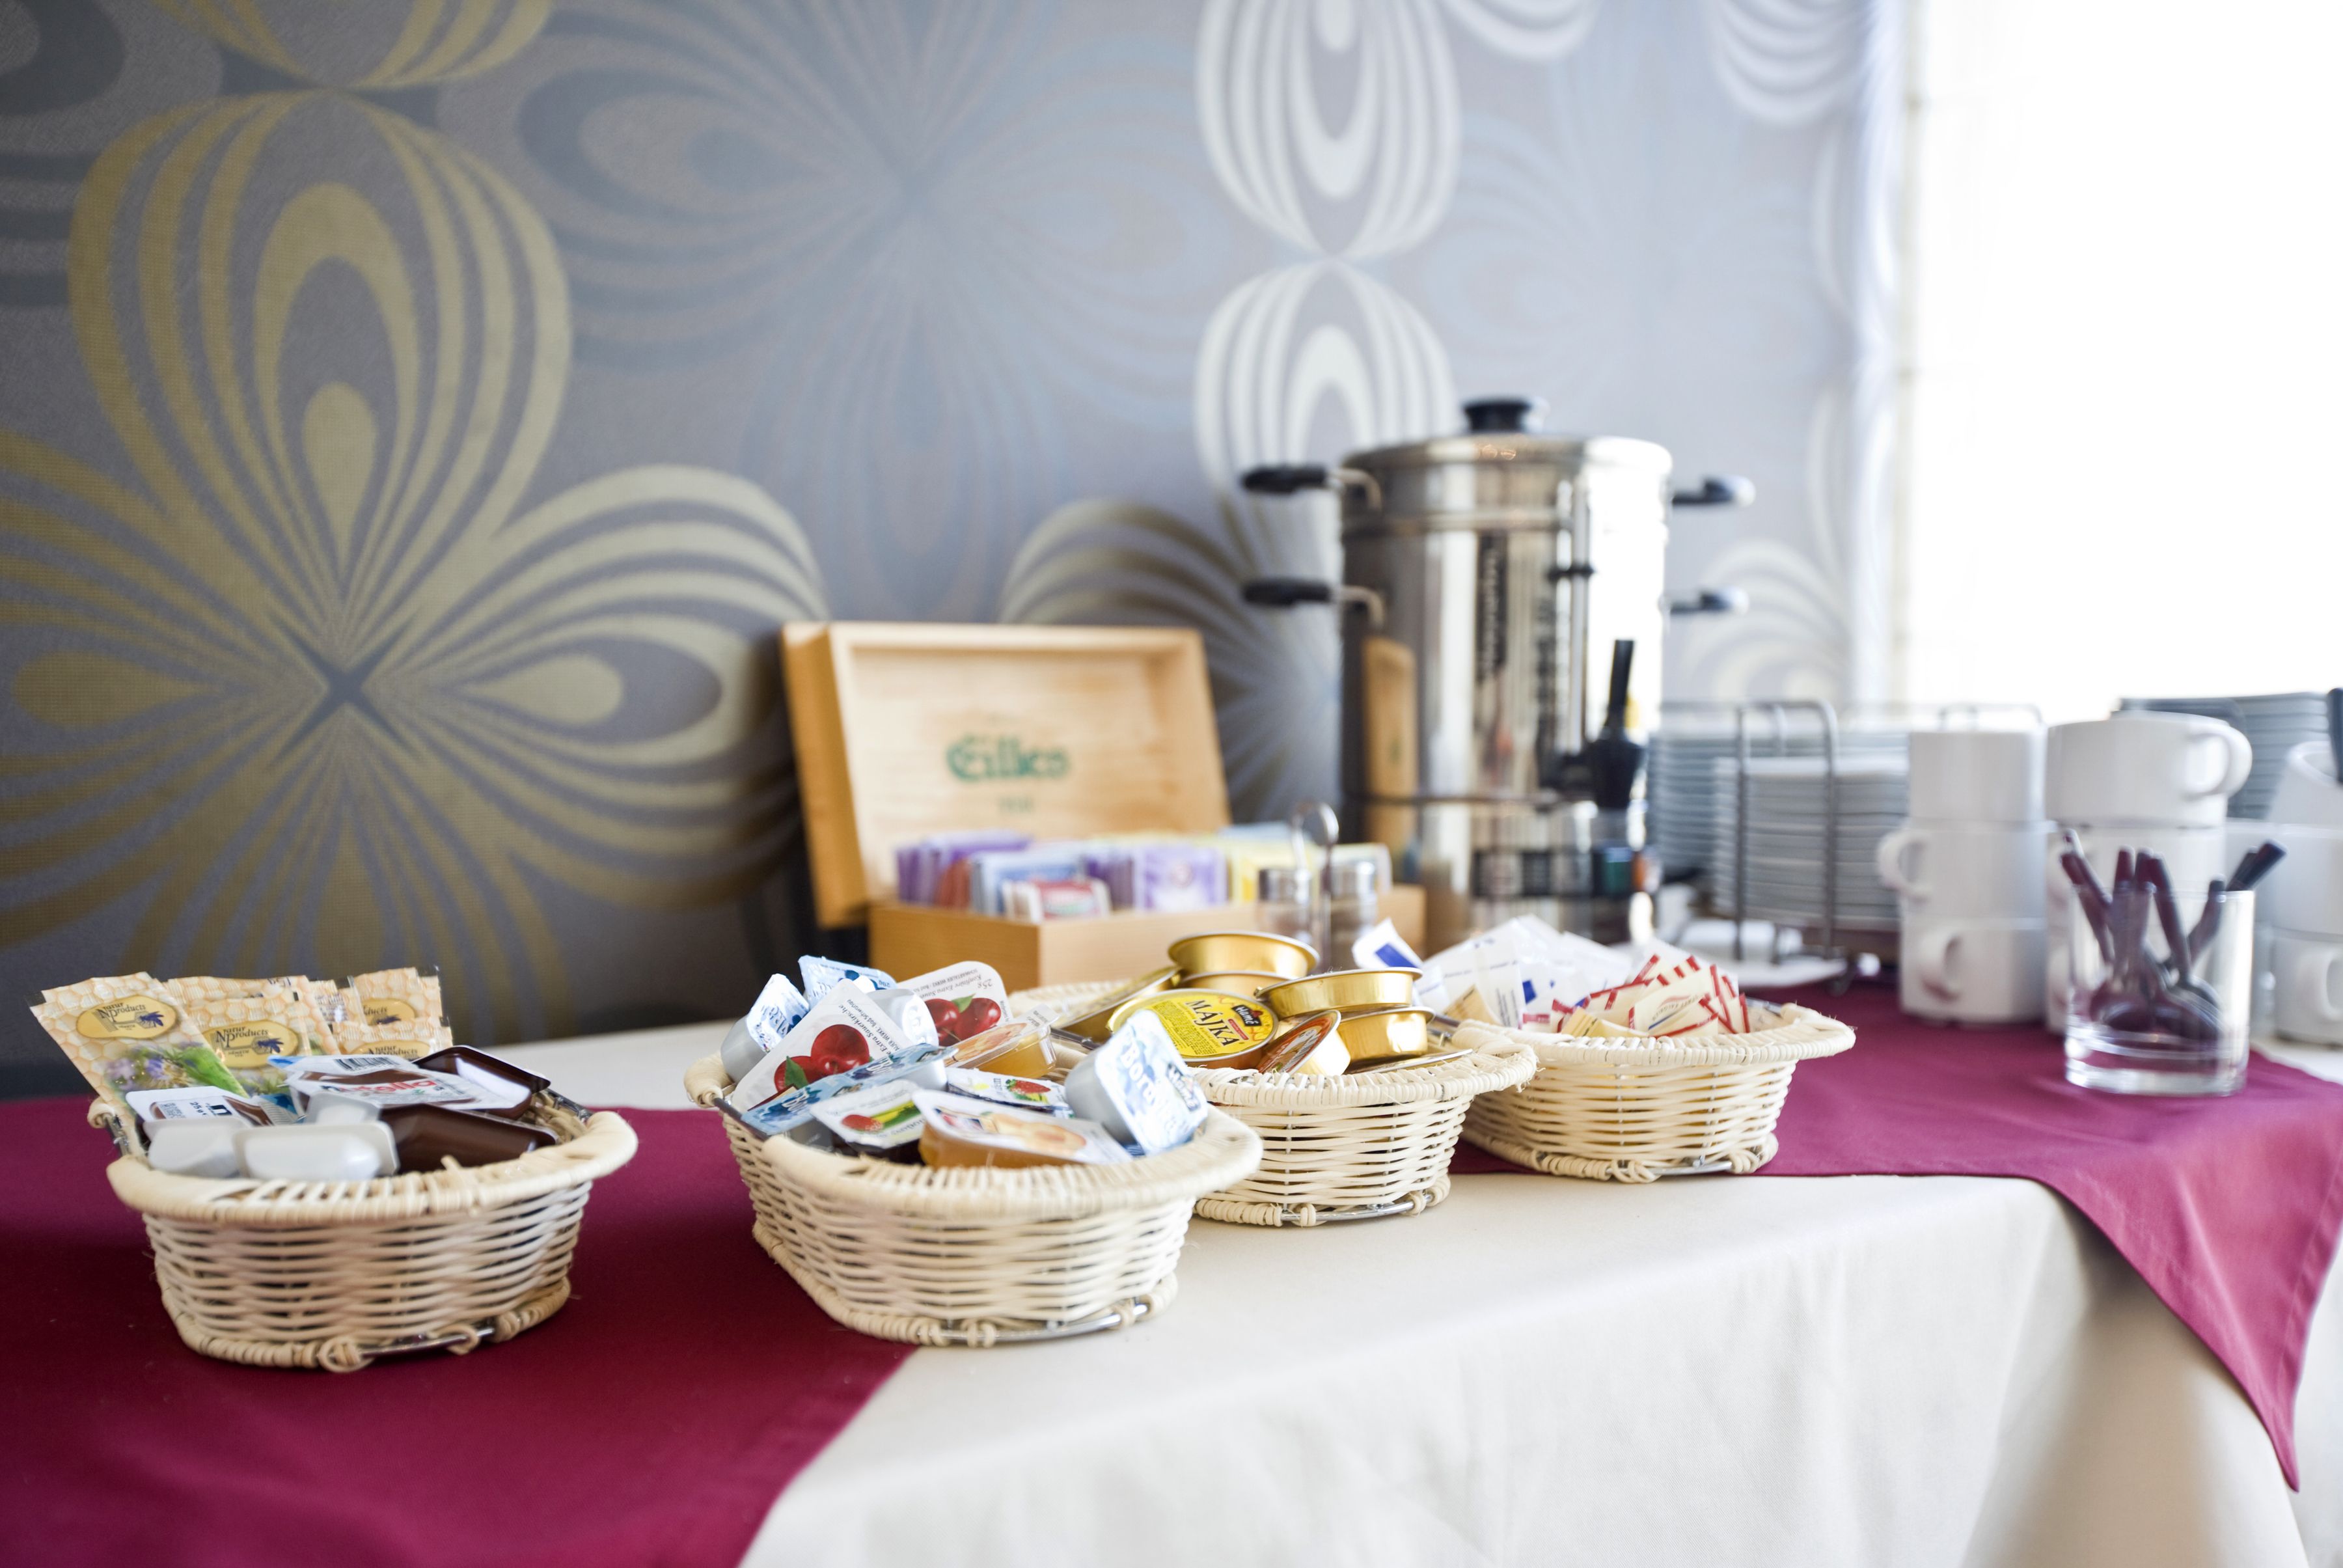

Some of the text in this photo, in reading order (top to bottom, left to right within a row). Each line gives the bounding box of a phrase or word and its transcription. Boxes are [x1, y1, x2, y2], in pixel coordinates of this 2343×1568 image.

[937, 984, 953, 993] Extra
[867, 1017, 877, 1028] Bad
[1185, 1000, 1240, 1046] MÁJKA
[1235, 1006, 1259, 1025] Hamé
[838, 1004, 888, 1052] Extra Sauerkirsche
[876, 1027, 890, 1042] WERKE
